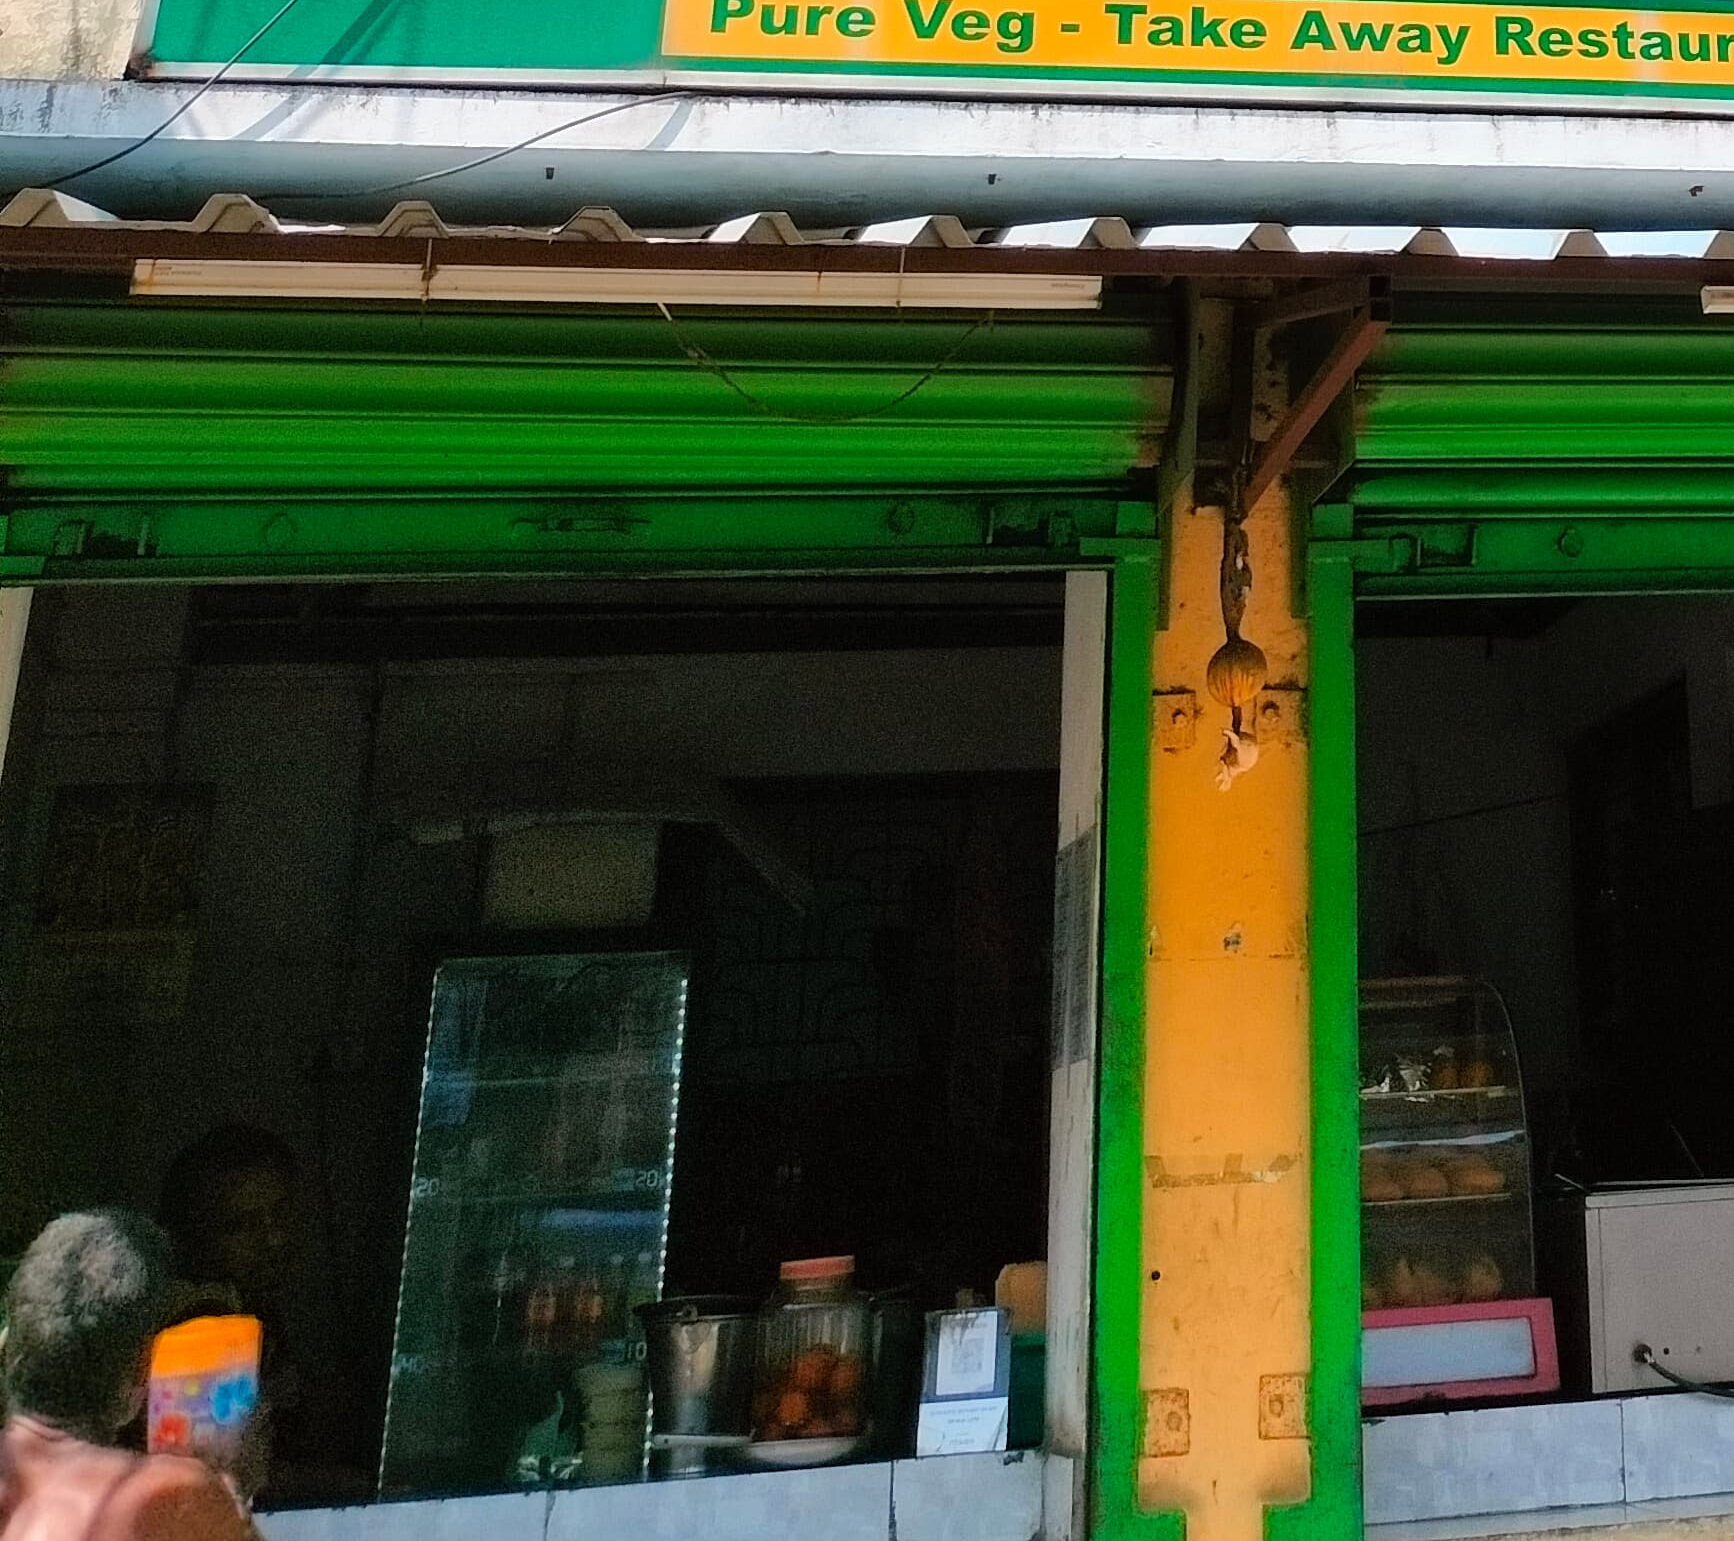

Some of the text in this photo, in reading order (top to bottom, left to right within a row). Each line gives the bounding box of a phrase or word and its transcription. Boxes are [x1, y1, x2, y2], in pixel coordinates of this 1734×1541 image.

[1060, 23, 1080, 33] -
[1104, 3, 1267, 49] Take
[1290, 10, 1470, 66] Away
